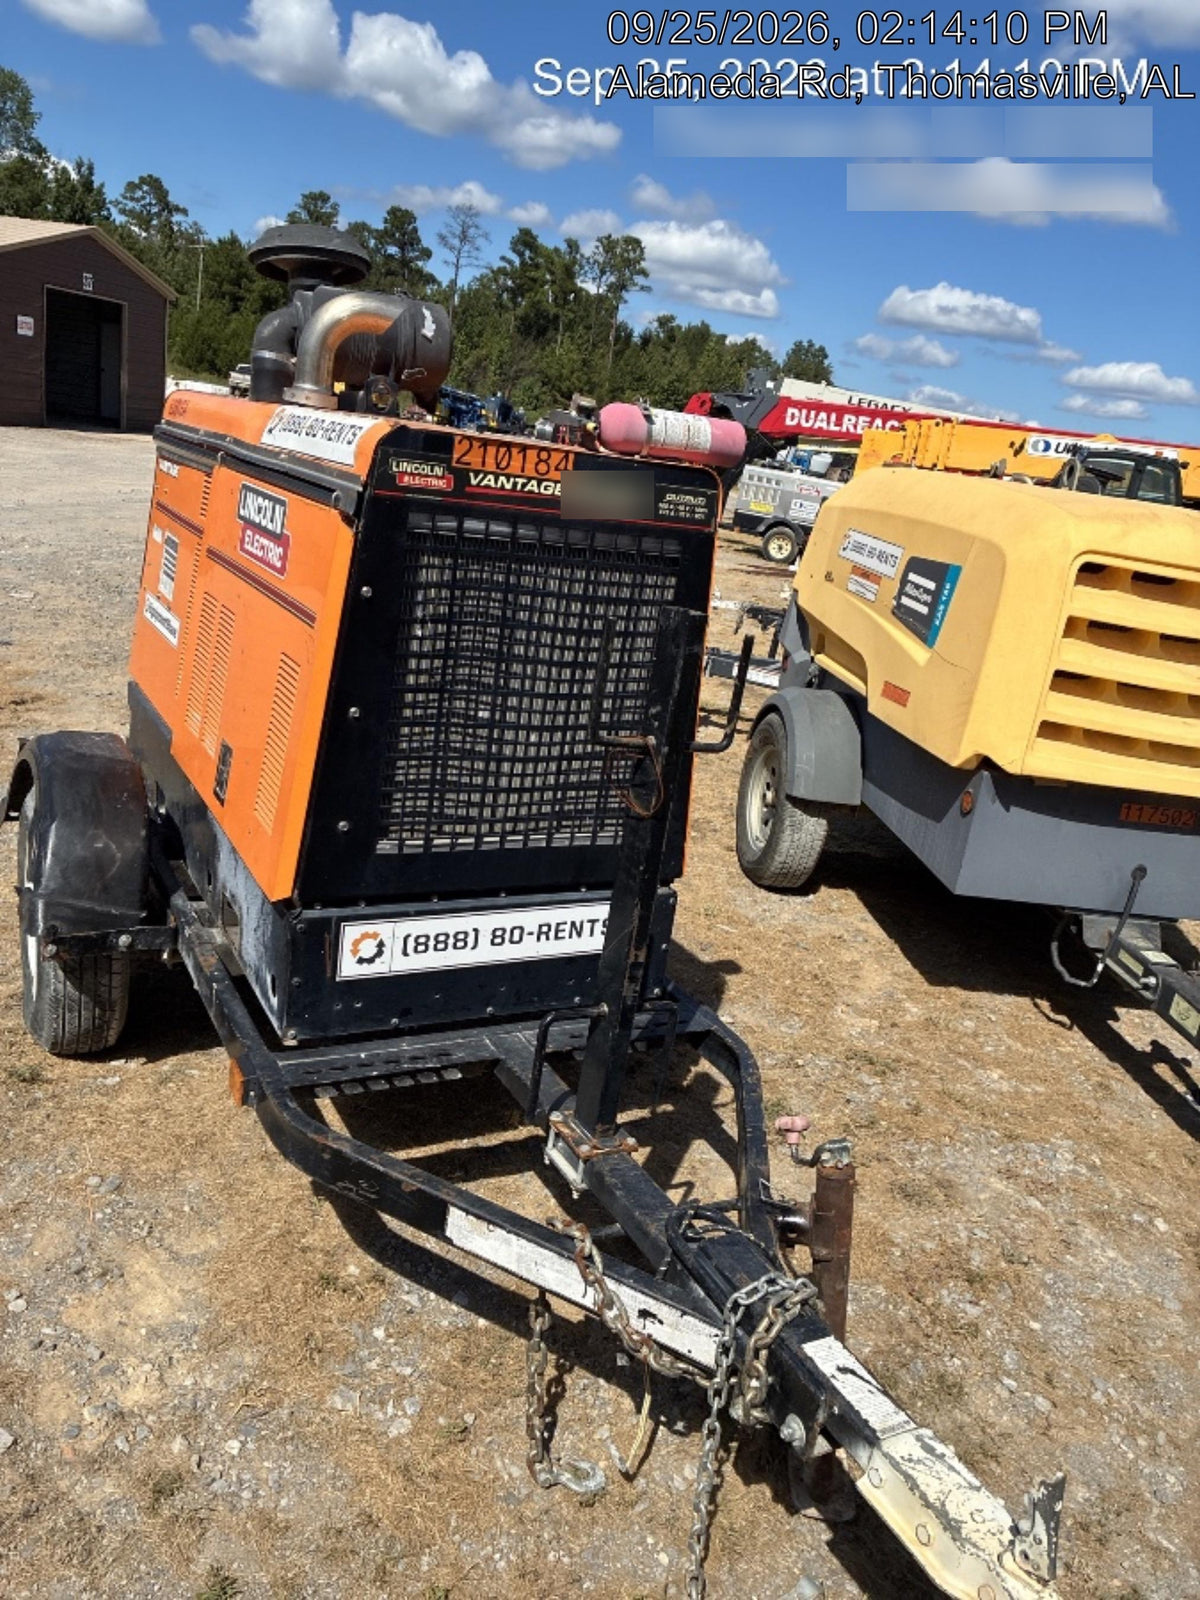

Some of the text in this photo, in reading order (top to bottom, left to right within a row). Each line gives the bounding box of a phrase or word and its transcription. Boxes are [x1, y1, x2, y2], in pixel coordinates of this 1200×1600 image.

[391, 461, 445, 478] LINCOLN
[454, 437, 571, 477] 210184
[402, 474, 448, 489] ELECTRIC
[239, 488, 285, 535] LINCOLN
[243, 528, 284, 568] ELECTRIC
[1123, 804, 1194, 826] 117502
[401, 927, 480, 957] (888)
